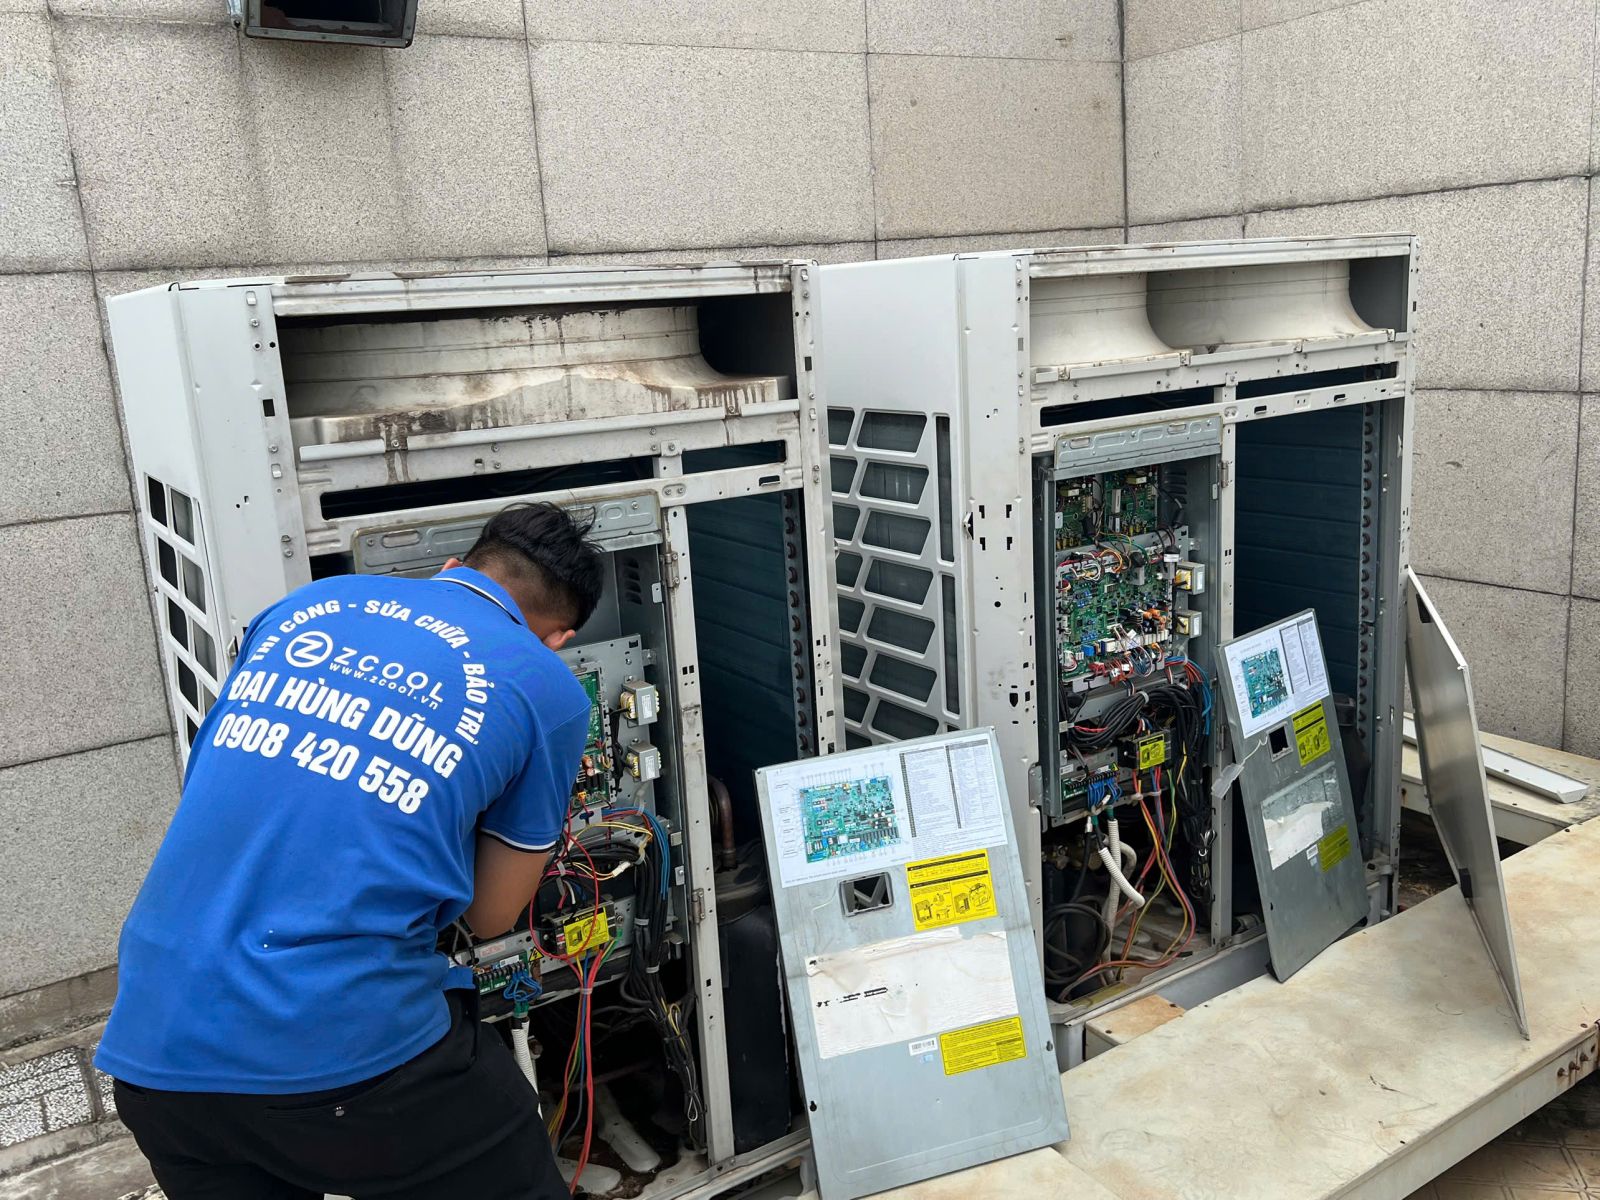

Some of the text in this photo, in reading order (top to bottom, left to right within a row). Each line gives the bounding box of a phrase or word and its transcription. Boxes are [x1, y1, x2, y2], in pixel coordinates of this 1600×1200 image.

[279, 599, 341, 634] CÔNG
[363, 599, 412, 622] SỬA
[248, 635, 280, 664] THI
[414, 615, 470, 649] CHỮA
[328, 662, 439, 710] www.zcool.vn
[333, 646, 444, 703] ZCOOL
[462, 663, 495, 705] BẢO
[227, 670, 463, 779] ĐẠI HÙNG DŨNG
[454, 706, 485, 745] TRÌ
[212, 713, 430, 815] 0908 420 558
